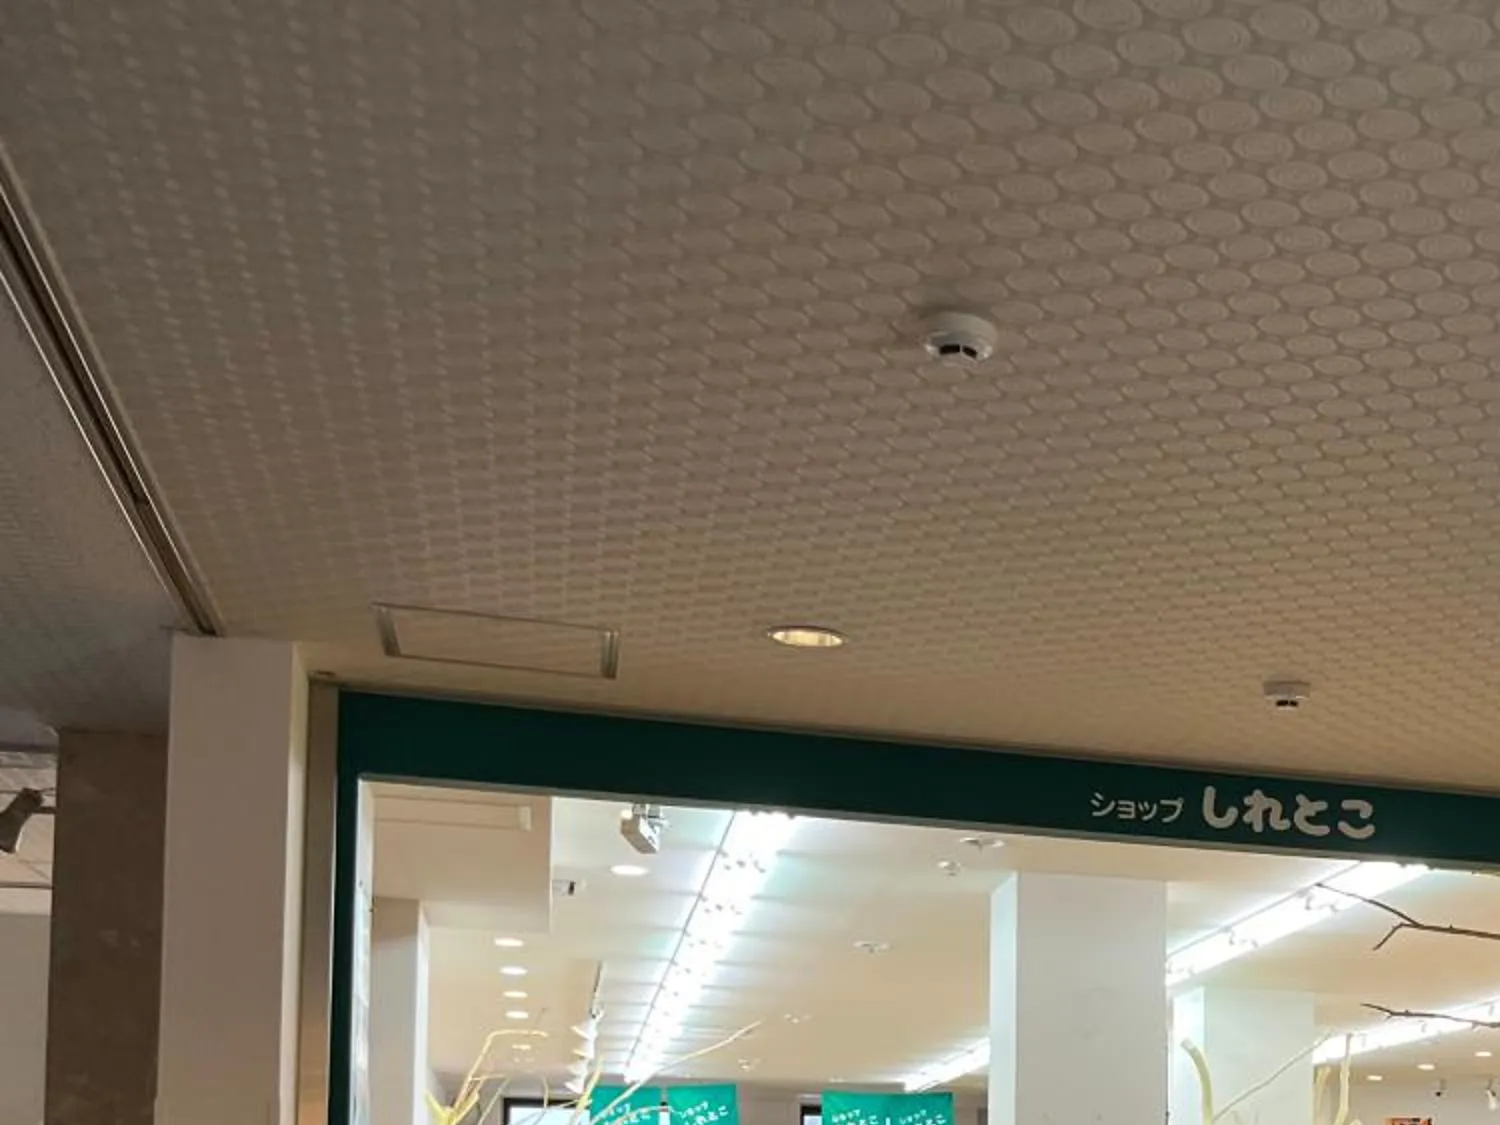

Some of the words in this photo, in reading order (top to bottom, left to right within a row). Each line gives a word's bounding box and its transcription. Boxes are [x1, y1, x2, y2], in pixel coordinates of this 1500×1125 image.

[1089, 792, 1184, 824] ショップ
[1202, 785, 1376, 839] しれとこ
